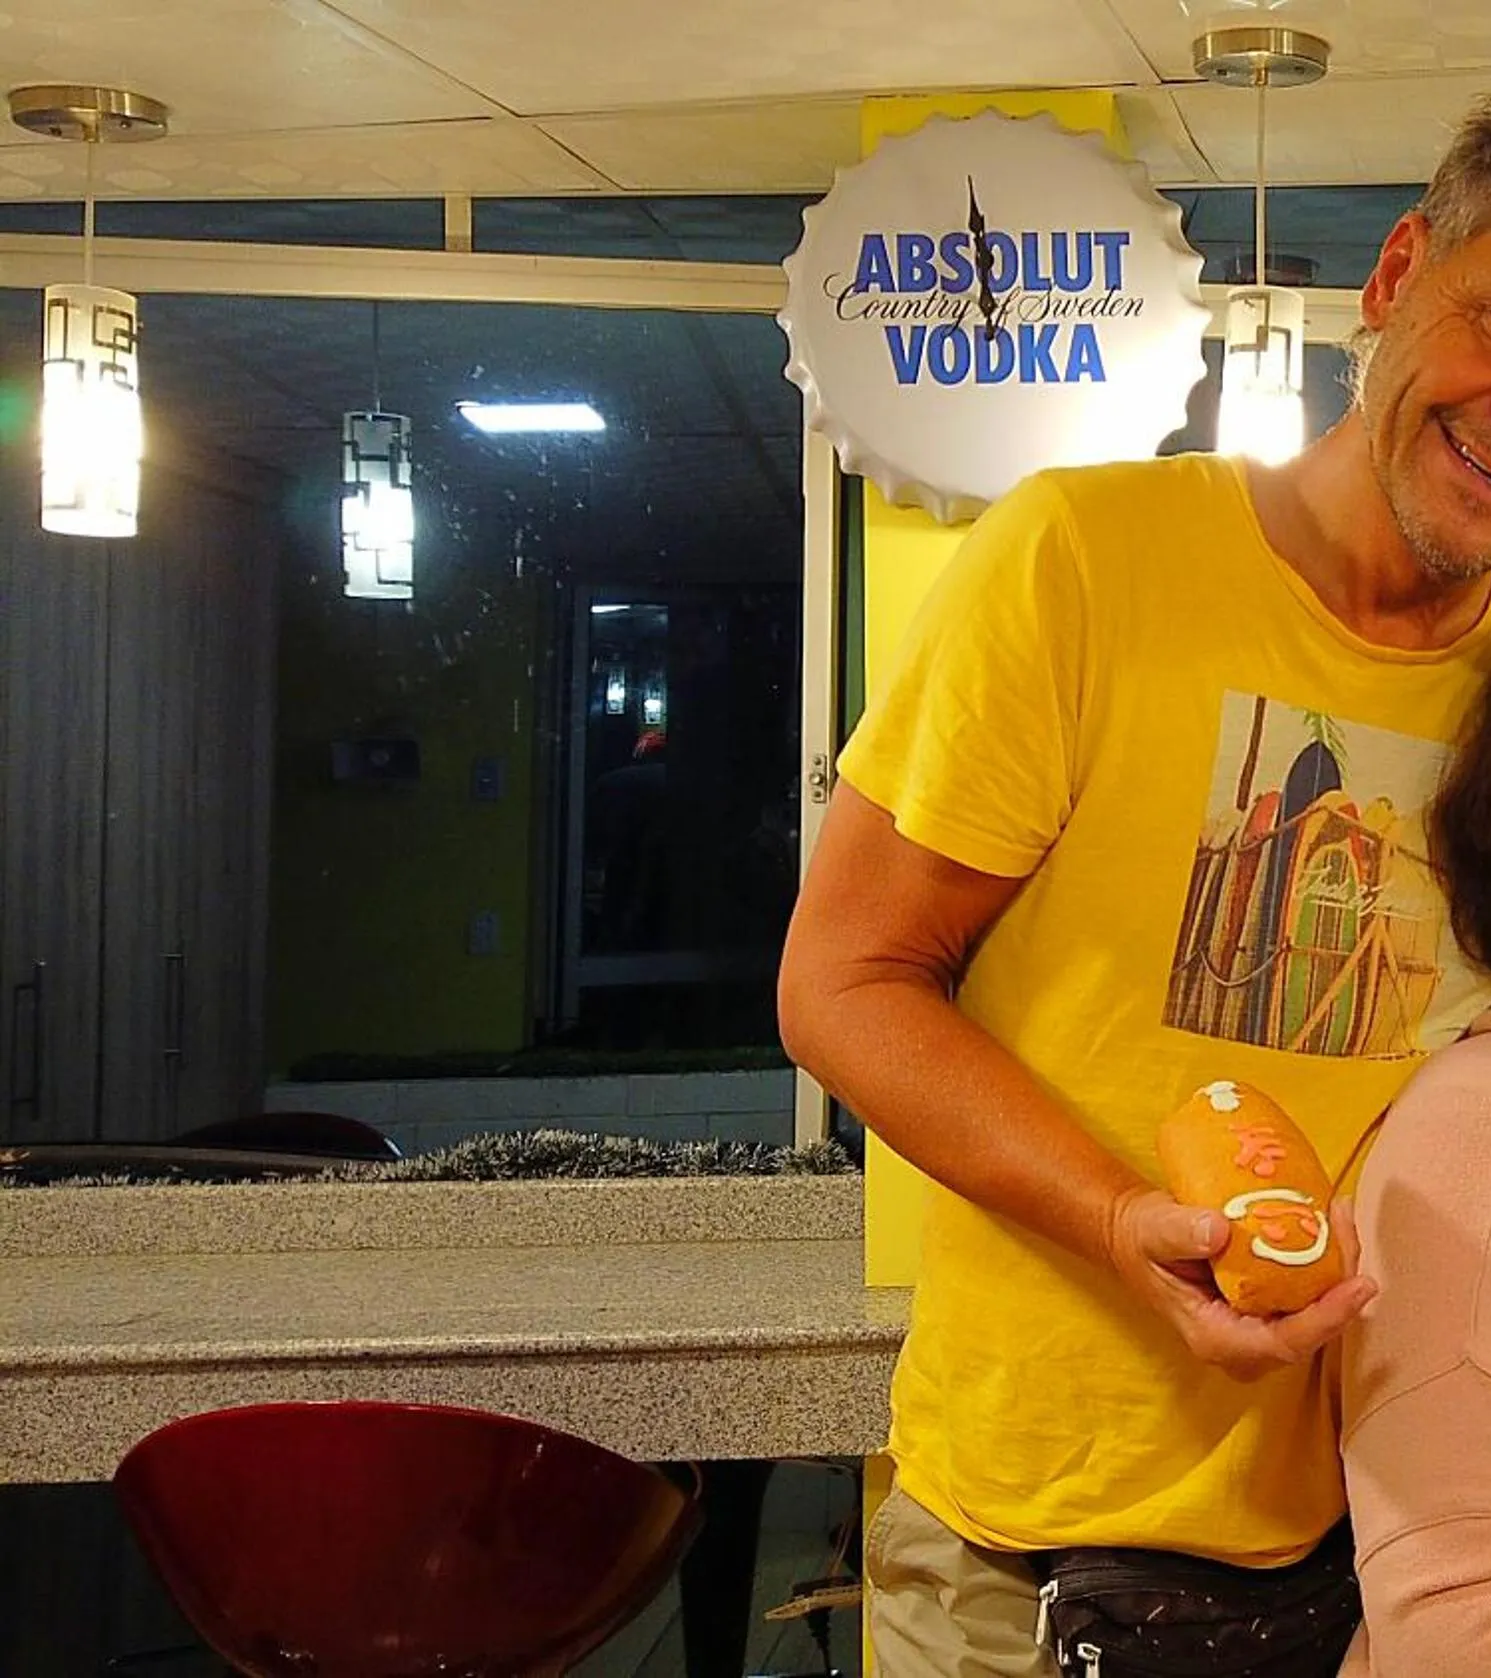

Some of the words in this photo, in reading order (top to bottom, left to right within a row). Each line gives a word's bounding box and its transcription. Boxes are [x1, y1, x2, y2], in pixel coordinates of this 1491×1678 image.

[855, 231, 1130, 294] ABSOLUT
[823, 273, 972, 338] Country
[978, 286, 1022, 332] f
[1018, 276, 1144, 321] Sweden
[884, 323, 1107, 386] VODKA
